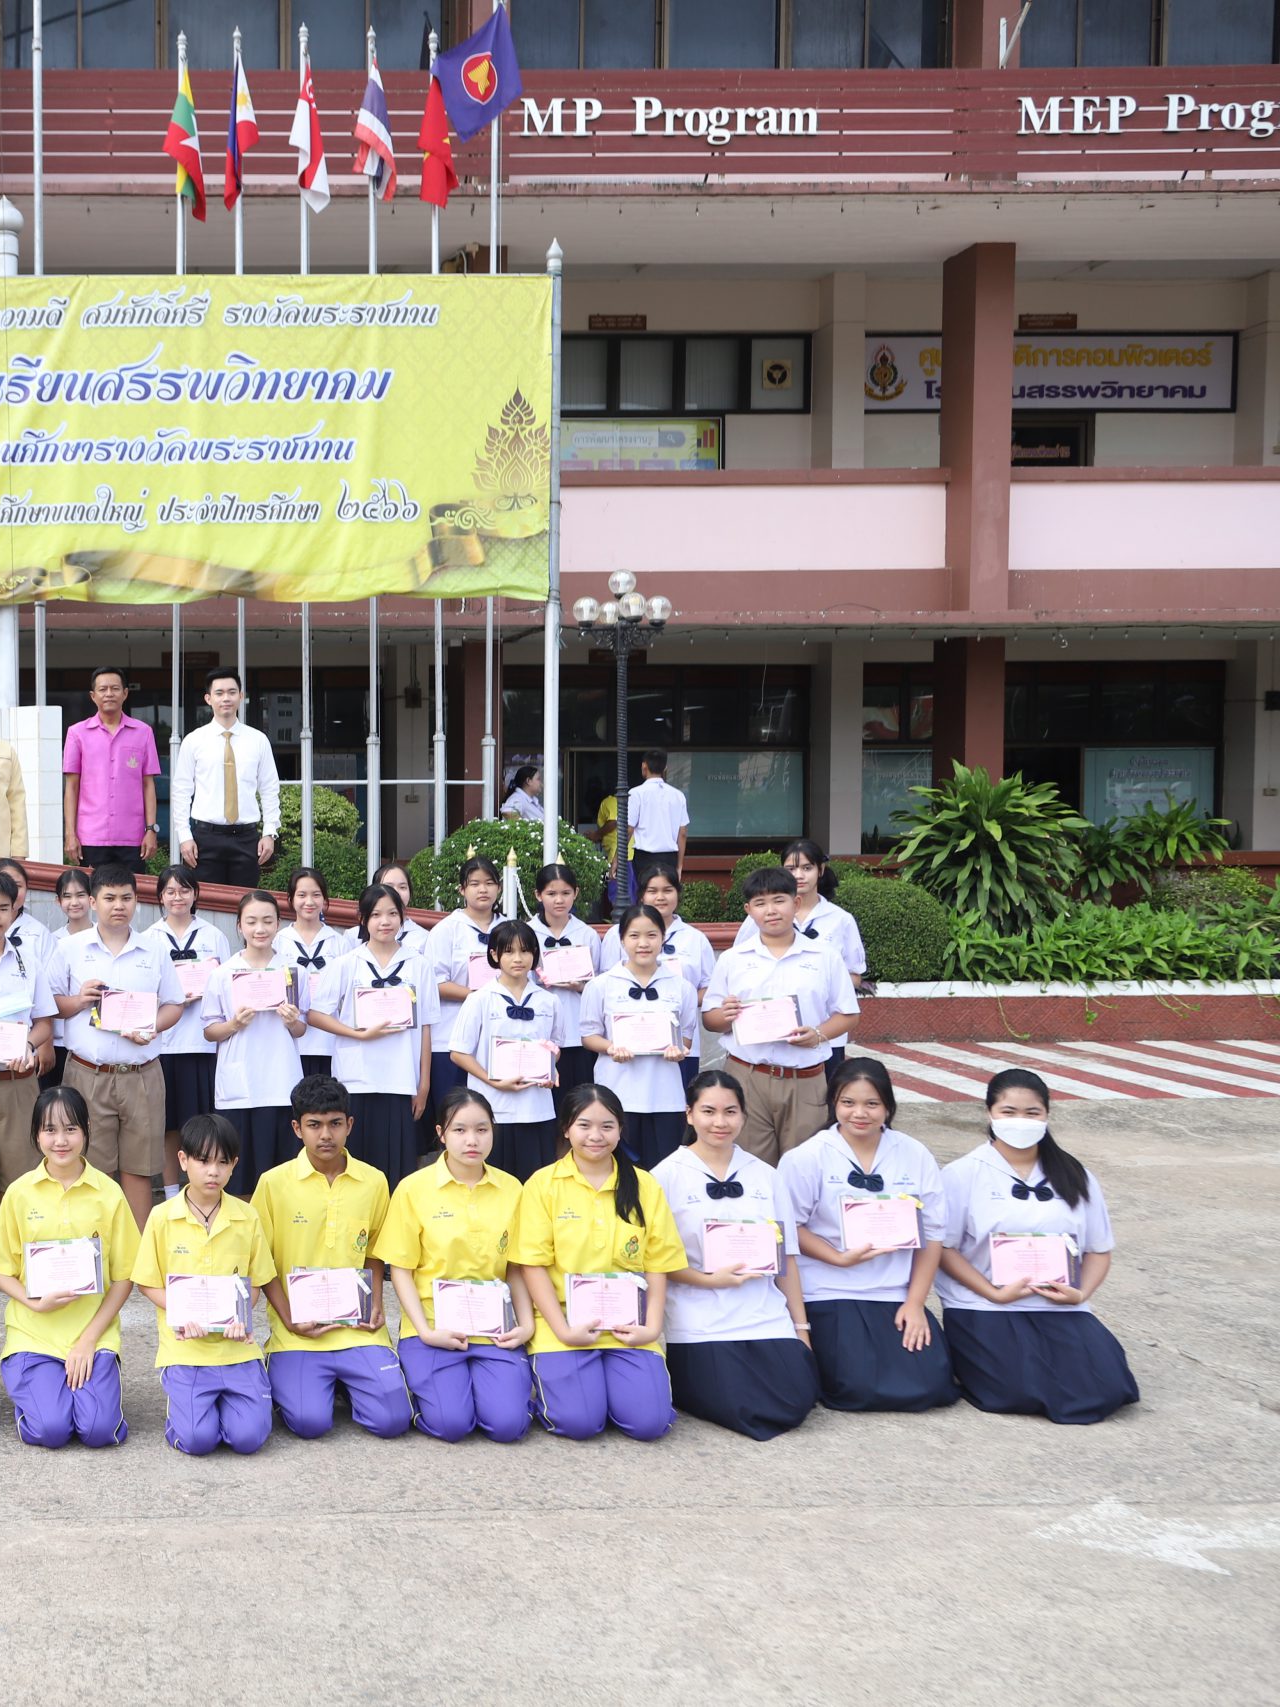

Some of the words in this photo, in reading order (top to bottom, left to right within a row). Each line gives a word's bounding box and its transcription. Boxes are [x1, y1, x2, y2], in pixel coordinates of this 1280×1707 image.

[521, 97, 603, 138] MP
[632, 96, 819, 146] Program
[1018, 95, 1138, 137] MEP
[1163, 93, 1280, 139] Prog
[81, 286, 209, 329] สมศักดิ์ศรี
[223, 290, 439, 328] รางวัลพระราชทาน
[157, 486, 322, 525] ประจำปีการศึกษา
